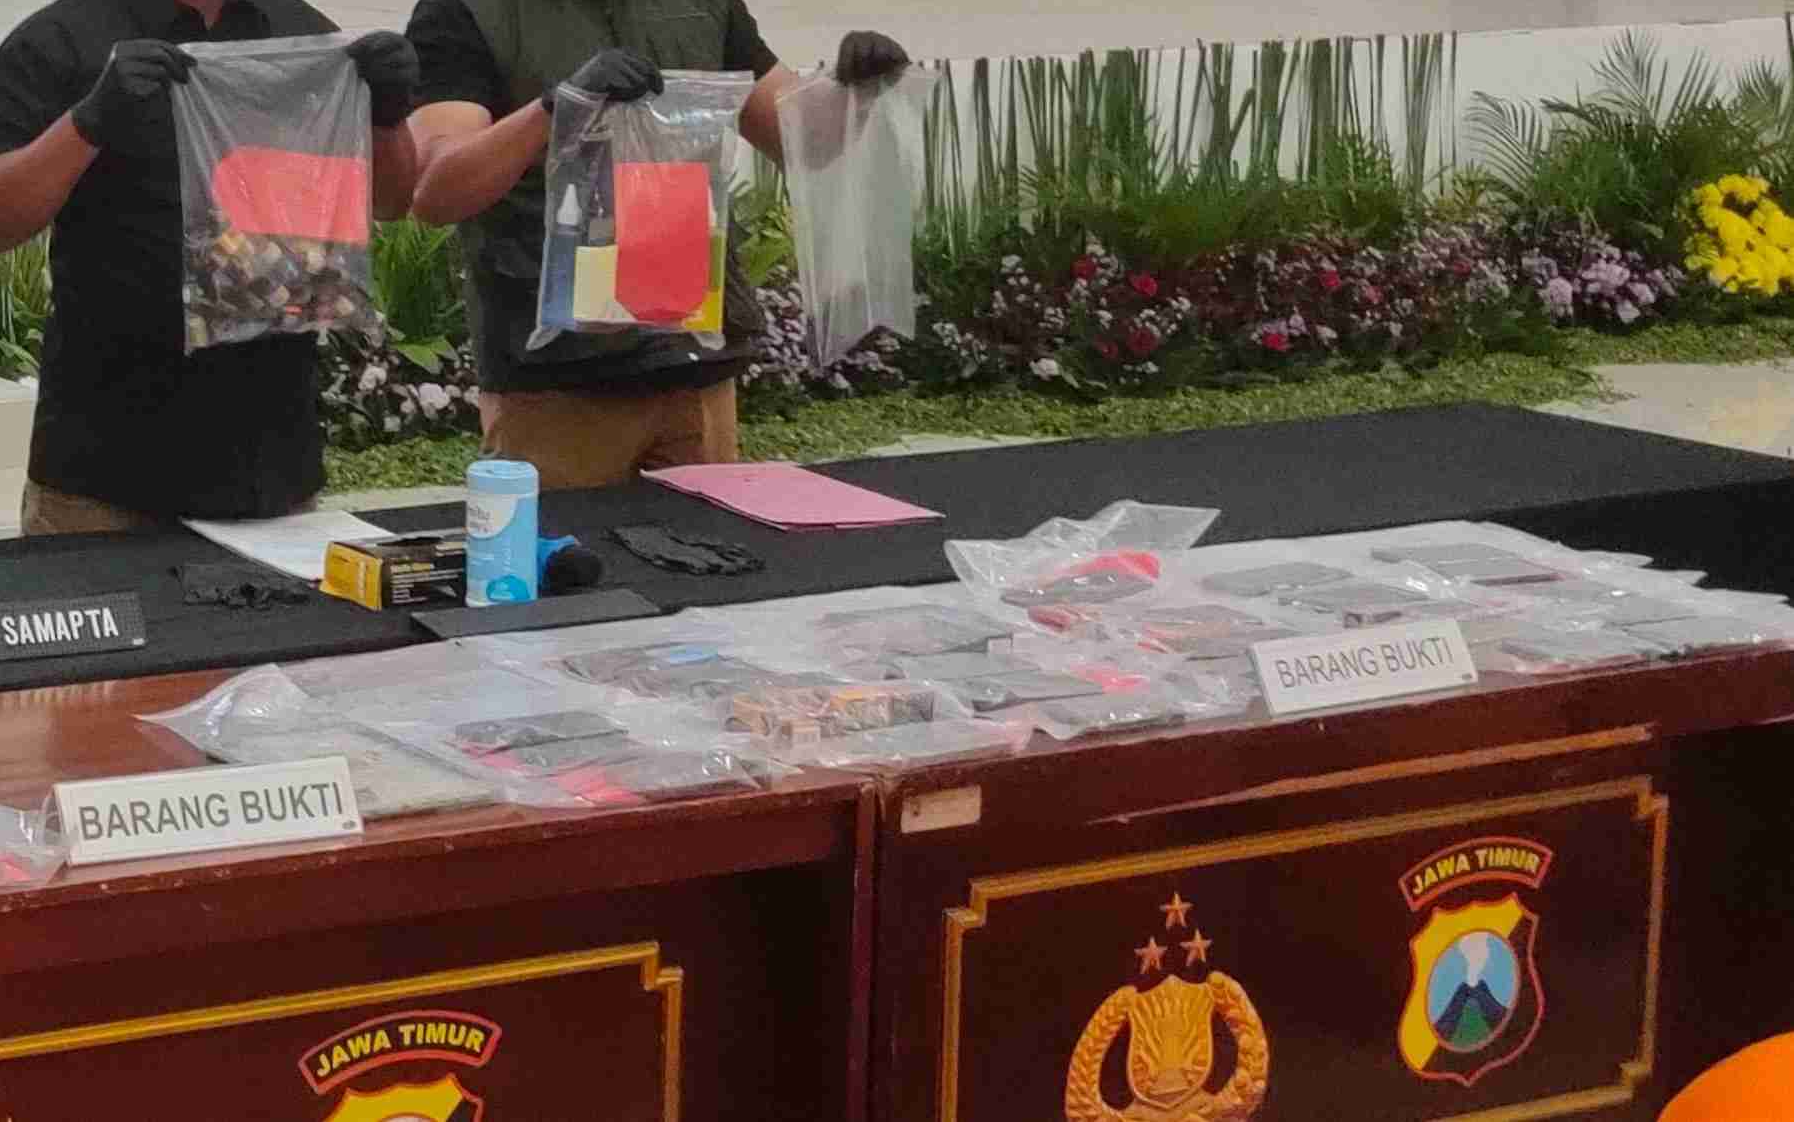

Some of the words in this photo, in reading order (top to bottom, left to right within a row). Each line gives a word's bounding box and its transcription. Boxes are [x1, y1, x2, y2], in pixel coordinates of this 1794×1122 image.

[1, 607, 119, 646] SAMAPTA
[1275, 647, 1381, 689] BARANG
[1381, 637, 1455, 673] BUKTI
[79, 793, 230, 841] BARANG
[240, 781, 343, 824] BUKTI
[1413, 853, 1471, 895] JAWA
[1474, 847, 1540, 874] TIMUR
[317, 1030, 392, 1078] JAWA
[399, 1022, 485, 1053] TIMUR
